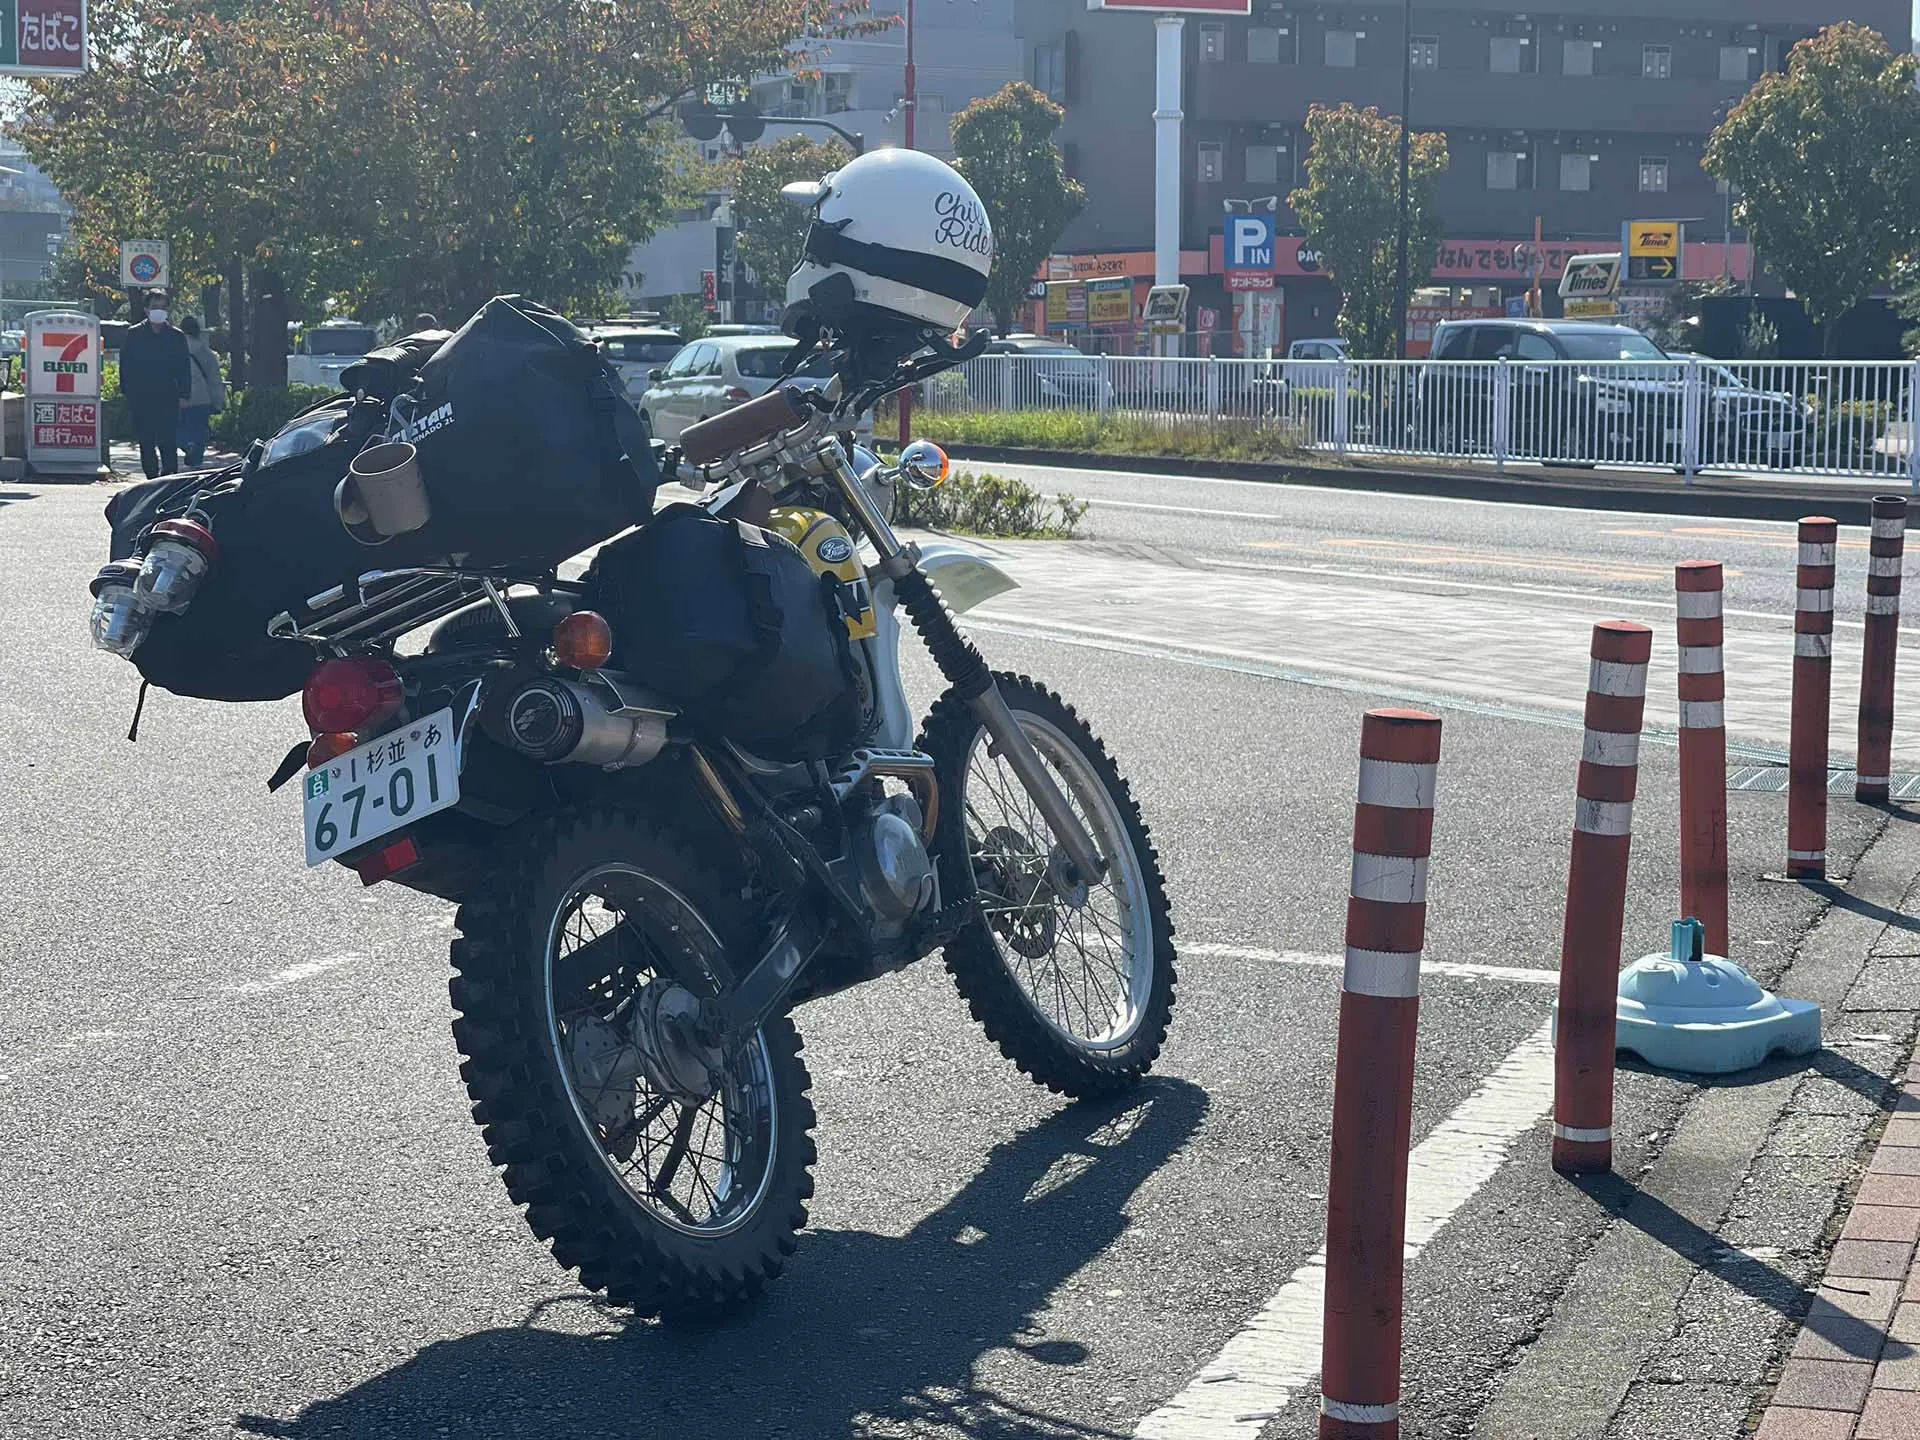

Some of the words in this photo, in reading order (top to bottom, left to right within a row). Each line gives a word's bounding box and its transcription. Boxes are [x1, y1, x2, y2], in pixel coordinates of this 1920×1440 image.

[21, 10, 80, 51] たばこ
[935, 217, 991, 255] Ride
[1234, 219, 1267, 264] P
[1640, 232, 1672, 247] Times
[1251, 248, 1270, 264] IN
[1231, 276, 1273, 287] サンドラッグ
[1566, 263, 1615, 292] Times
[36, 404, 55, 422] 酒
[57, 405, 95, 423] たばこ
[314, 753, 439, 851] 67-01
